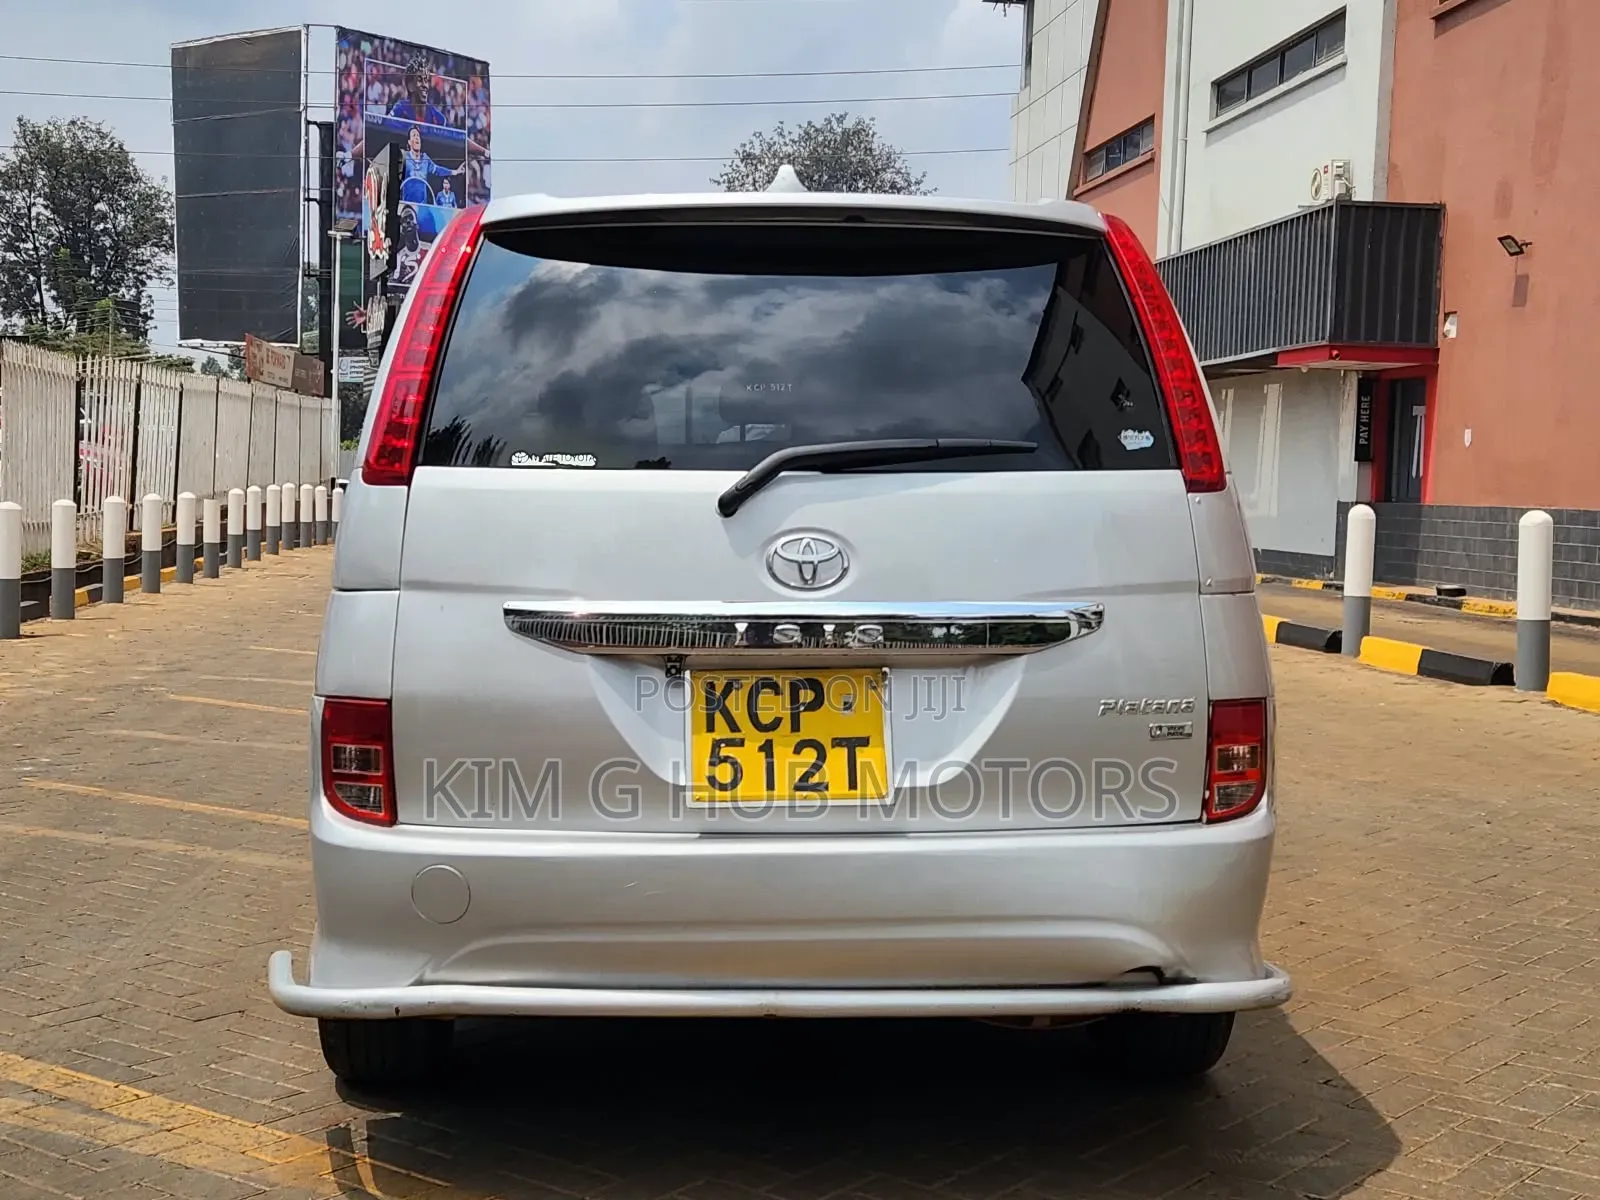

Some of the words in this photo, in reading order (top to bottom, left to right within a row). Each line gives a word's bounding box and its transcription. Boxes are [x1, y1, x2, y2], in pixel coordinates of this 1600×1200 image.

[1360, 395, 1370, 422] HERE
[1359, 426, 1369, 445] PAY
[704, 676, 826, 734] KCP
[704, 735, 871, 793] 512T
